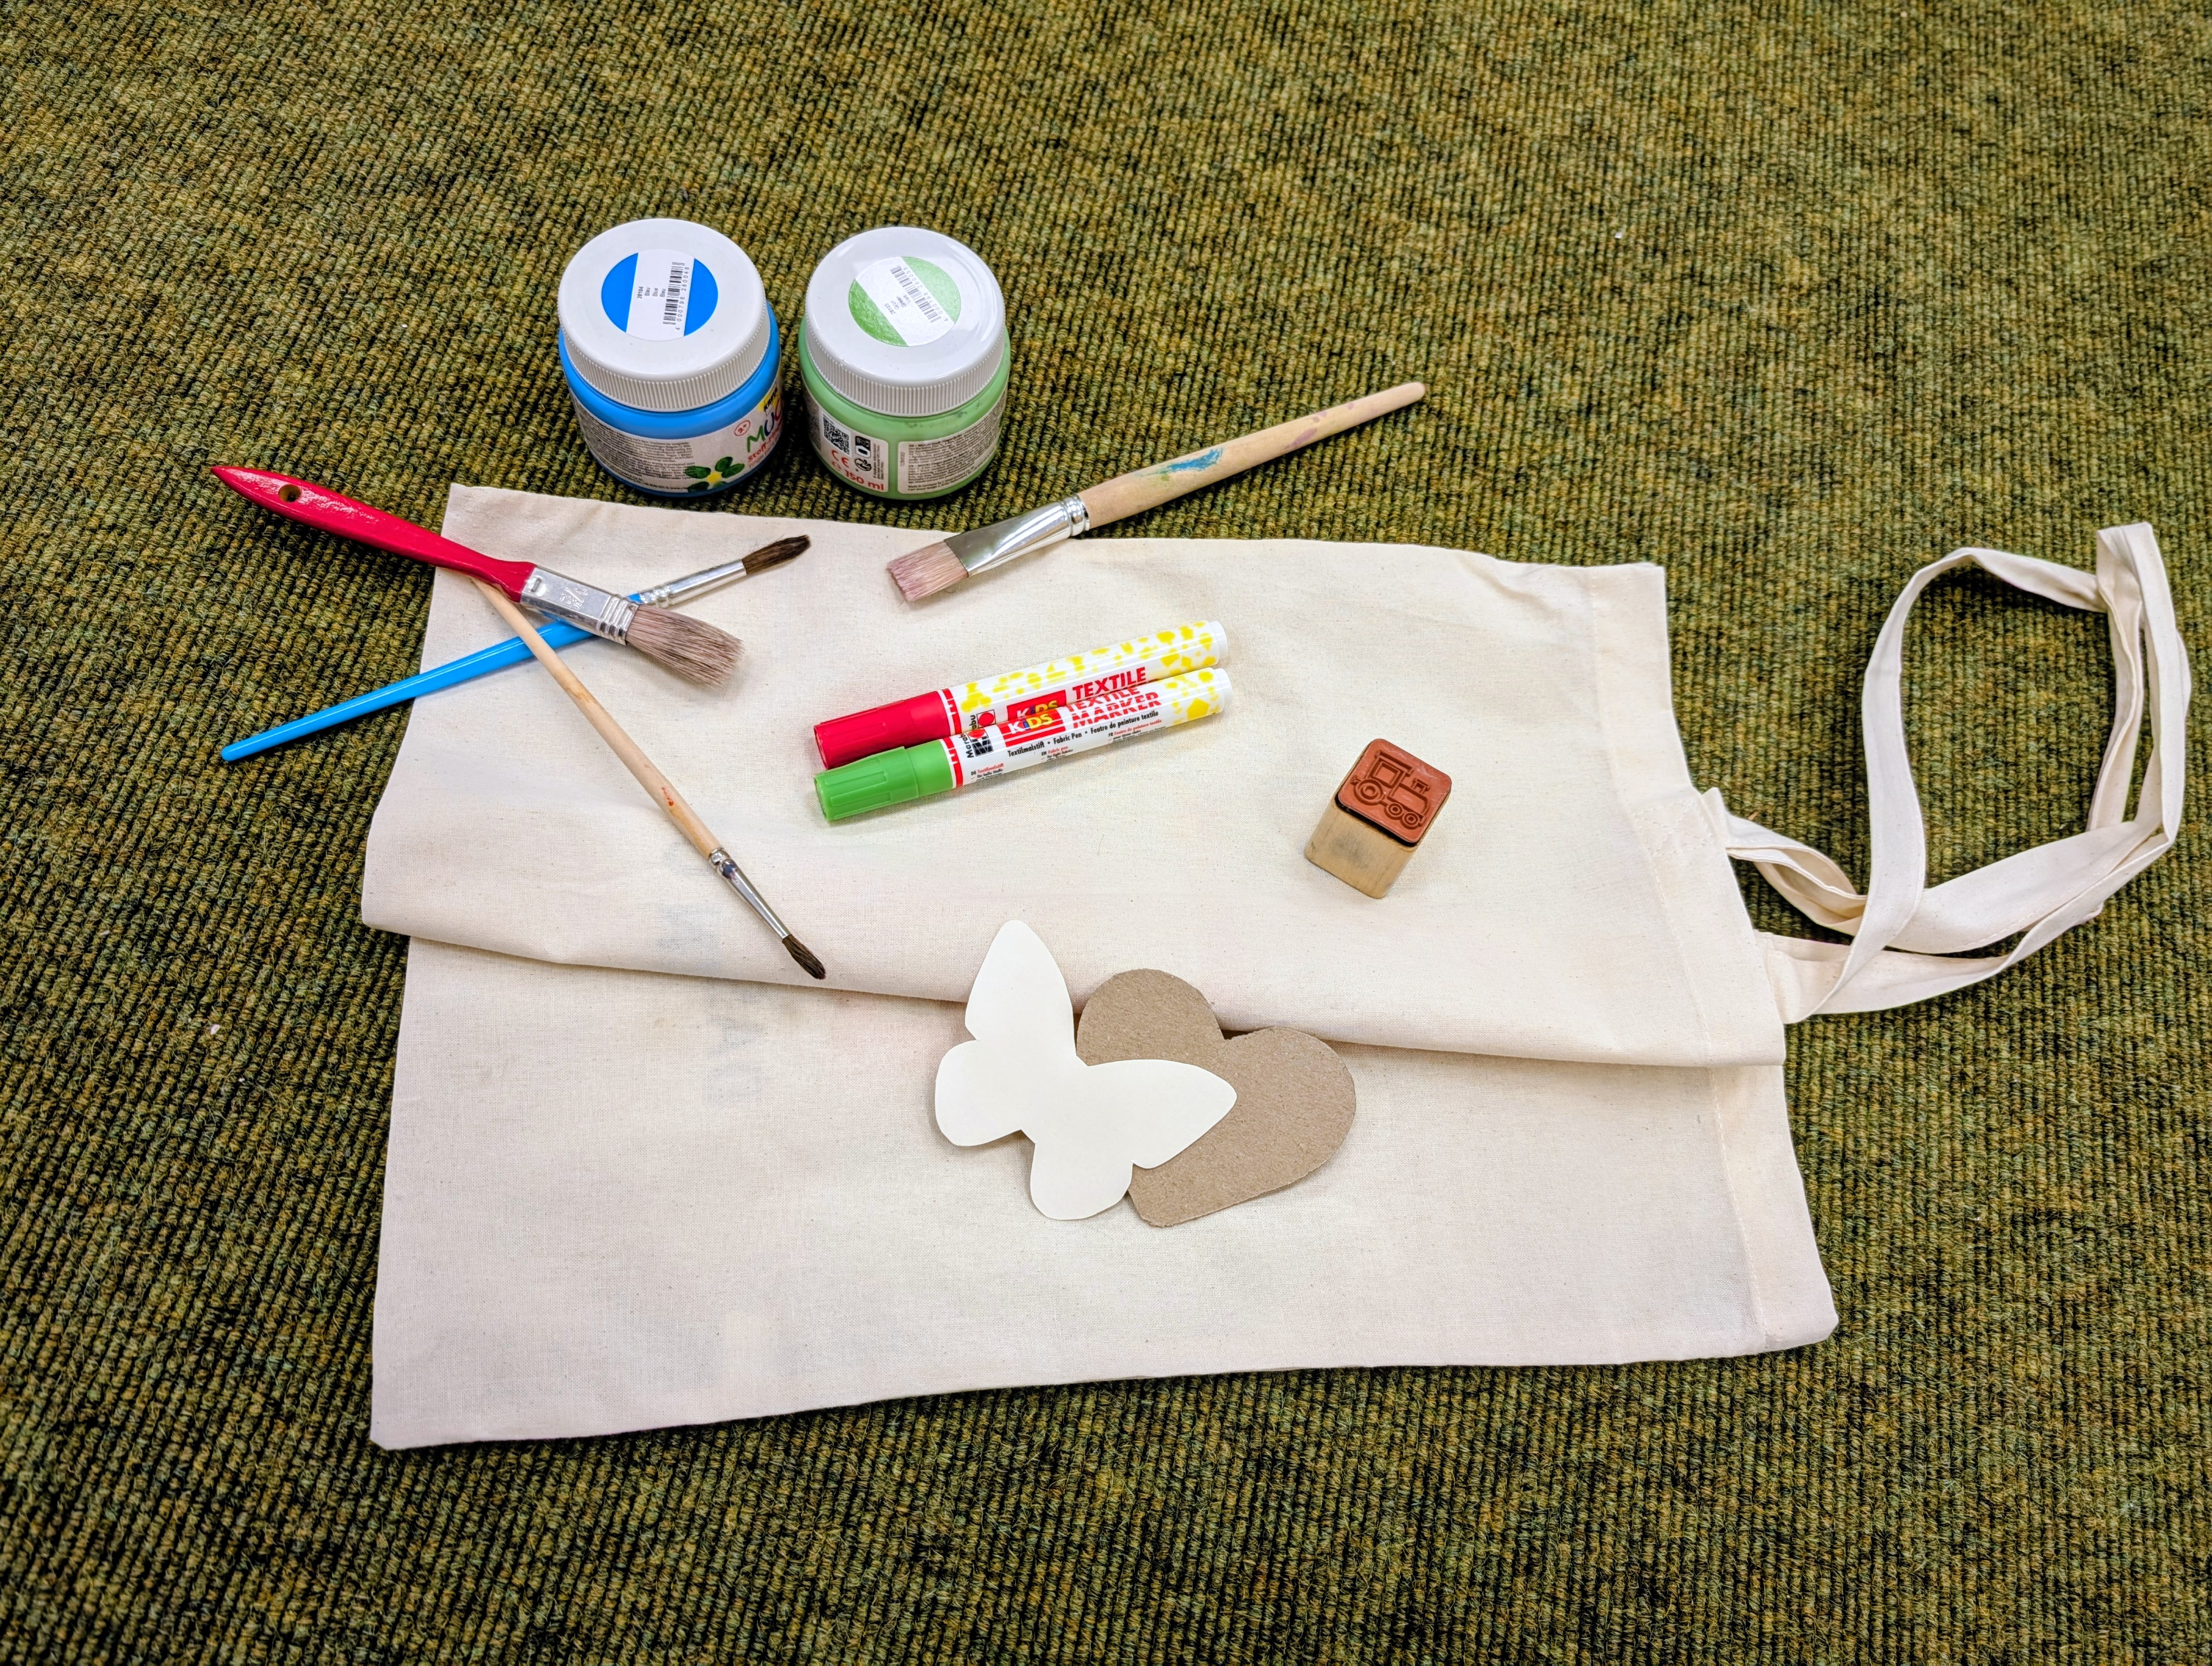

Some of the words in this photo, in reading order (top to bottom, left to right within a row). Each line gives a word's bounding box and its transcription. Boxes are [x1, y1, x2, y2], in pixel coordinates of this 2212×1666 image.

[677, 297, 685, 322] 000798
[681, 267, 690, 291] 280048
[896, 296, 906, 307] Green
[923, 292, 943, 315] 000798
[845, 470, 864, 484] 150
[868, 480, 884, 491] ml
[1072, 667, 1146, 700] TEXTILE
[1071, 692, 1161, 729] MARKER
[1007, 741, 1045, 757] Textilmalstift
[1053, 734, 1070, 745] Fabric
[1071, 732, 1082, 740] Pen
[1090, 724, 1108, 734] Feutre
[1117, 716, 1140, 728] peinture
[1141, 710, 1159, 720] textile
[1008, 713, 1053, 734] KiDS
[959, 733, 974, 758] Marab
